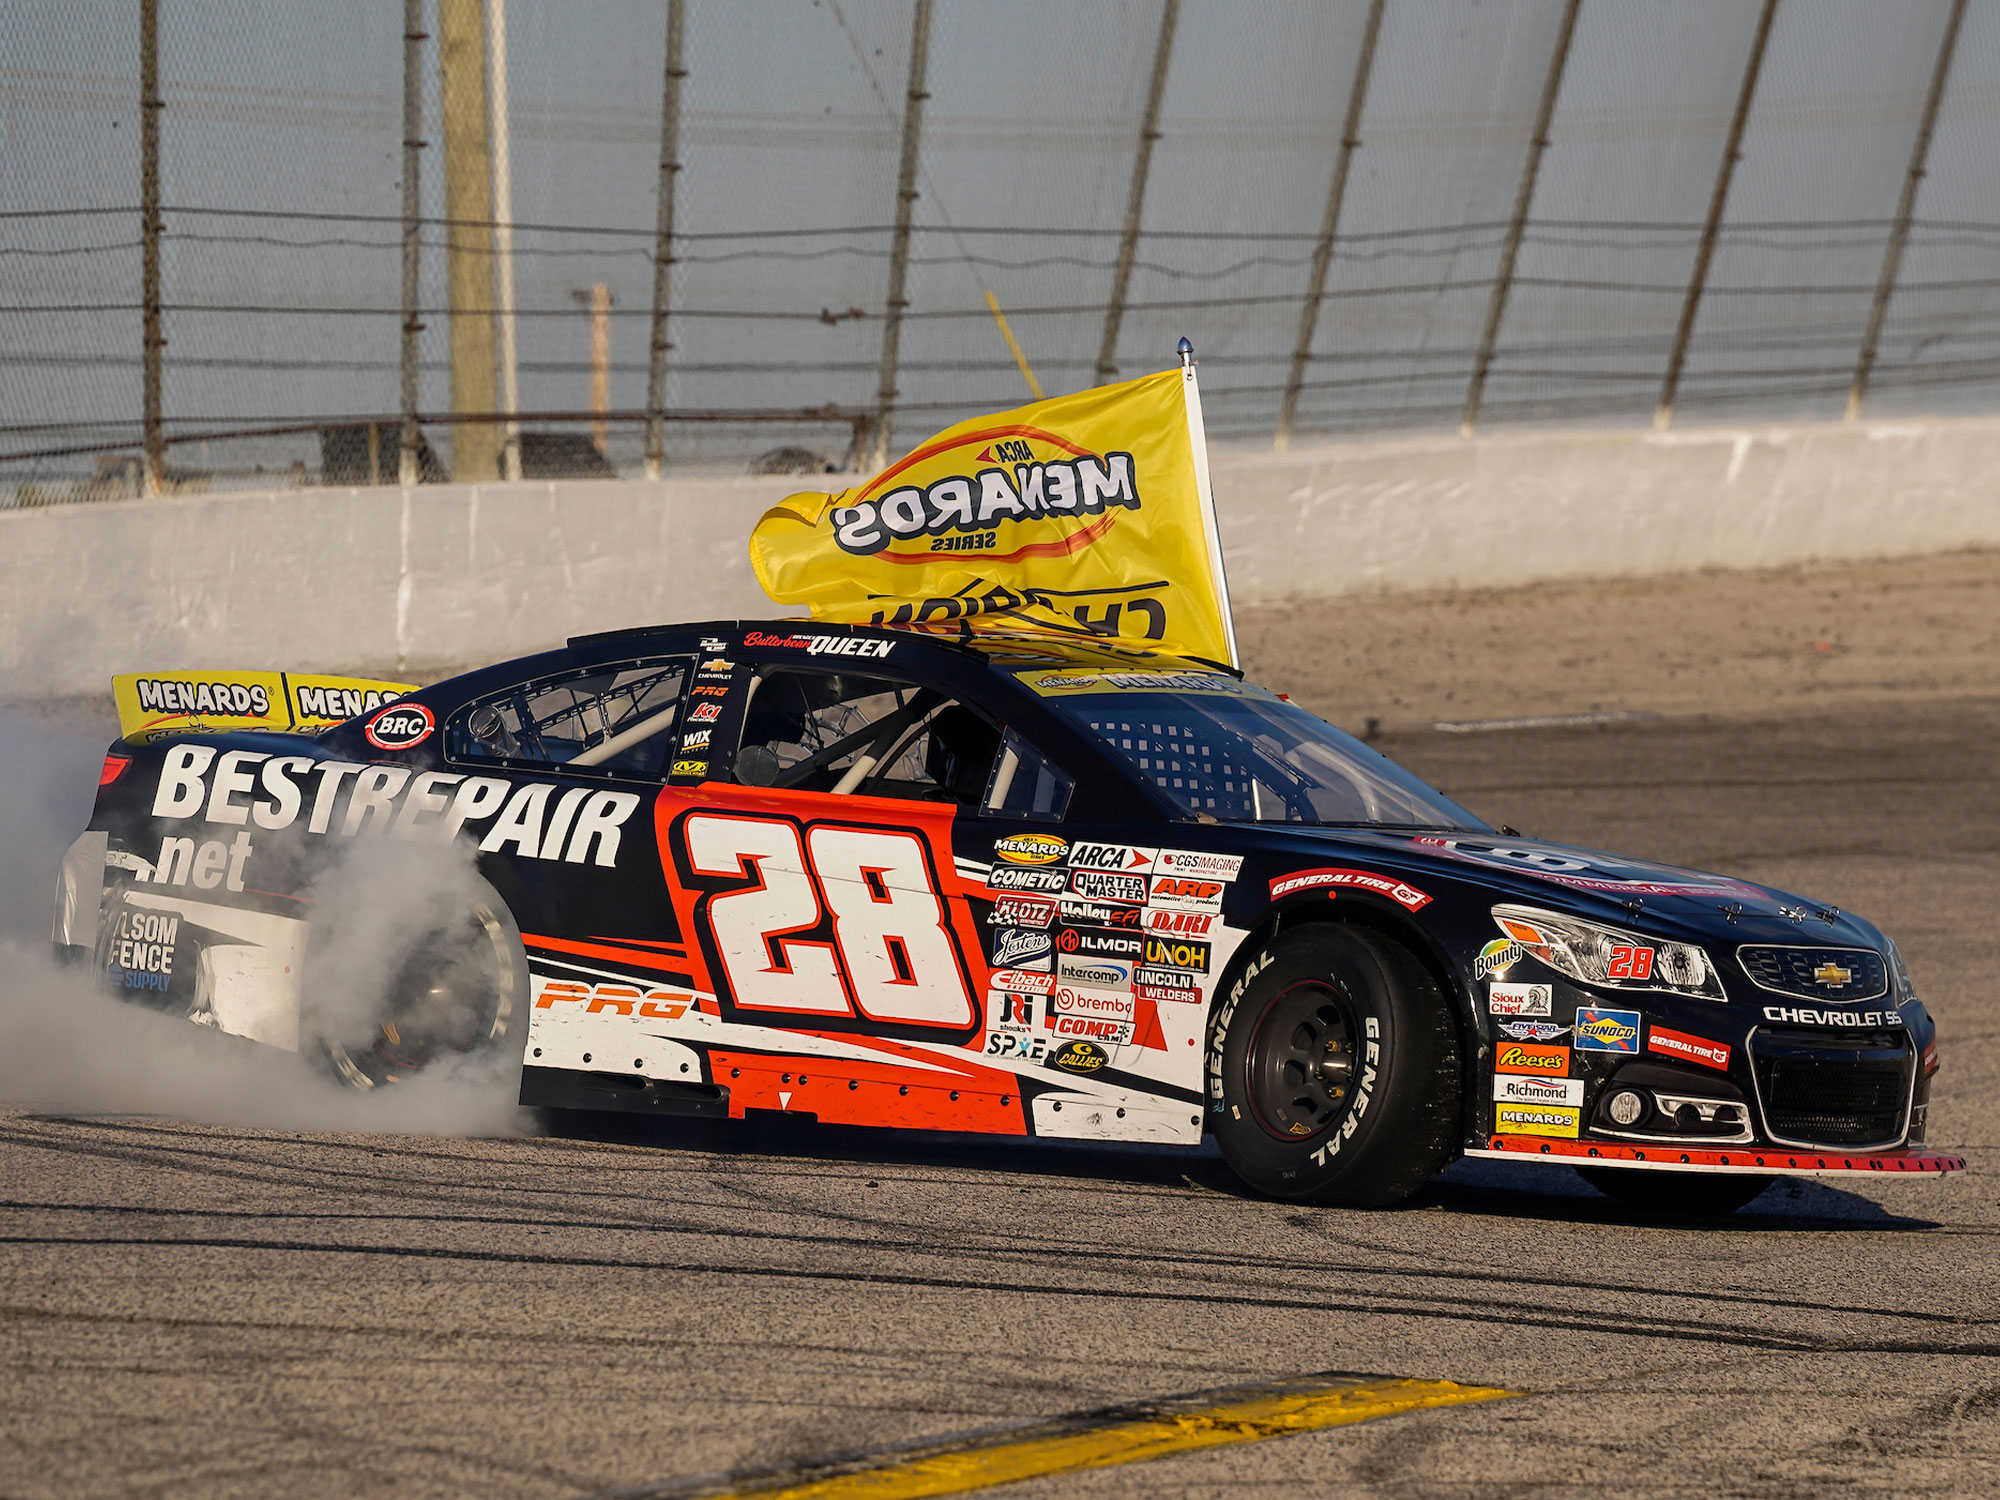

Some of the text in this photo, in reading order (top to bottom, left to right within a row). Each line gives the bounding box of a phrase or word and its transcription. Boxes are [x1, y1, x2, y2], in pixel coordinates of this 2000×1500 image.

[744, 632, 811, 649] Butterbean
[807, 635, 897, 658] QUEEN
[691, 686, 729, 697] PRG
[1037, 676, 1098, 689] MENARDS
[137, 679, 270, 715] MENARDS
[693, 702, 723, 719] K1
[376, 716, 424, 735] BRC
[683, 730, 712, 747] WIX
[151, 743, 641, 868] BESTREPAIR
[994, 839, 1070, 857] MENARDS
[1070, 845, 1127, 869] ARCA
[991, 868, 1066, 890] COMETIC
[1075, 873, 1143, 890] QUARTER
[1152, 878, 1222, 898] ARP
[1272, 874, 1353, 896] GENERAL
[1353, 875, 1395, 891] TIRE
[1085, 885, 1145, 901] MASTER
[1000, 900, 1051, 921] KLOTZ
[683, 814, 976, 1030] 28
[1152, 911, 1213, 934] DART
[1081, 936, 1142, 953] ILMOR
[1146, 938, 1205, 969] UNOH
[1474, 941, 1524, 980] Bounty
[1607, 945, 1655, 980] 28
[125, 971, 171, 992] SUPPLY
[991, 969, 1054, 995] Eibach
[1061, 963, 1120, 985] Intercomp
[535, 982, 695, 1020] PRG
[1077, 994, 1132, 1013] brembo
[1145, 986, 1196, 1002] WELDERS
[1491, 992, 1524, 1003] Sioux
[1491, 1003, 1521, 1014] Chief
[1762, 1006, 1902, 1027] CHEVROLET SS
[1058, 1018, 1118, 1037] COMP
[1210, 950, 1275, 1100] GENERAL
[1512, 1022, 1534, 1031] FIVE
[1582, 1024, 1634, 1038] SUNOCO
[1650, 1035, 1693, 1053] GENERAL
[1692, 1045, 1714, 1058] TIRE
[1059, 1053, 1103, 1068] CALLIES
[1500, 1047, 1566, 1069] Reese's
[1310, 1016, 1381, 1168] GENERAL
[1507, 1083, 1567, 1099] Richmond
[1501, 1111, 1573, 1126] MENARDS
